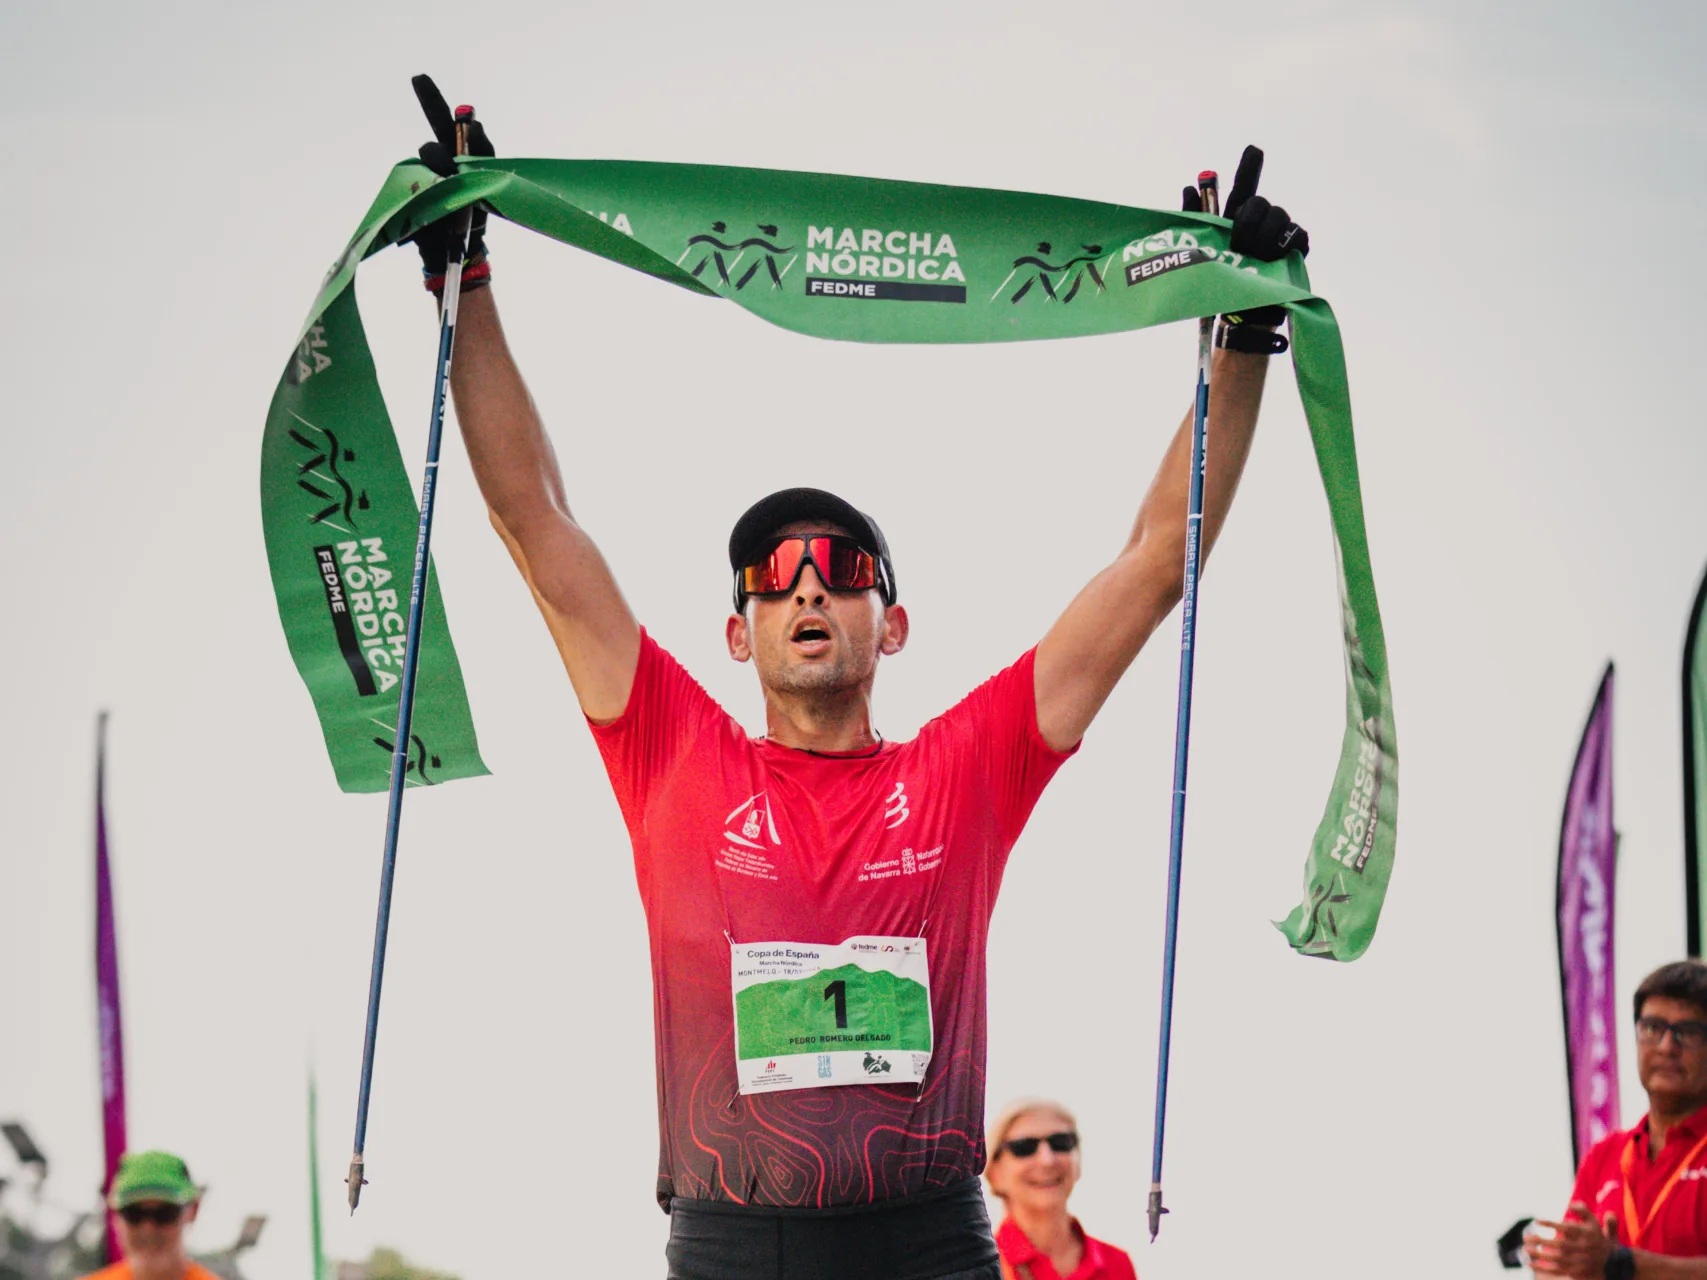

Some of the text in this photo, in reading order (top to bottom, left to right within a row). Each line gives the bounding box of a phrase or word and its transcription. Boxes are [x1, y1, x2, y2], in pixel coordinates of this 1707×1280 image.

[807, 225, 958, 257] MARCHA
[805, 249, 966, 282] NÓRDICA
[1130, 250, 1191, 281] FEDME
[811, 281, 876, 297] FEDME
[318, 550, 347, 614] FEDME
[336, 540, 399, 693] NÓRDICA
[361, 537, 406, 669] MARCH
[1182, 621, 1192, 650] LITE
[1356, 806, 1379, 868] FEDME
[858, 869, 901, 882] de Navarra
[864, 859, 900, 871] Gobierno
[747, 949, 820, 959] Copa de España
[824, 980, 848, 1028] 1
[789, 1034, 891, 1045] PEDRO ROMERO DELGADO
